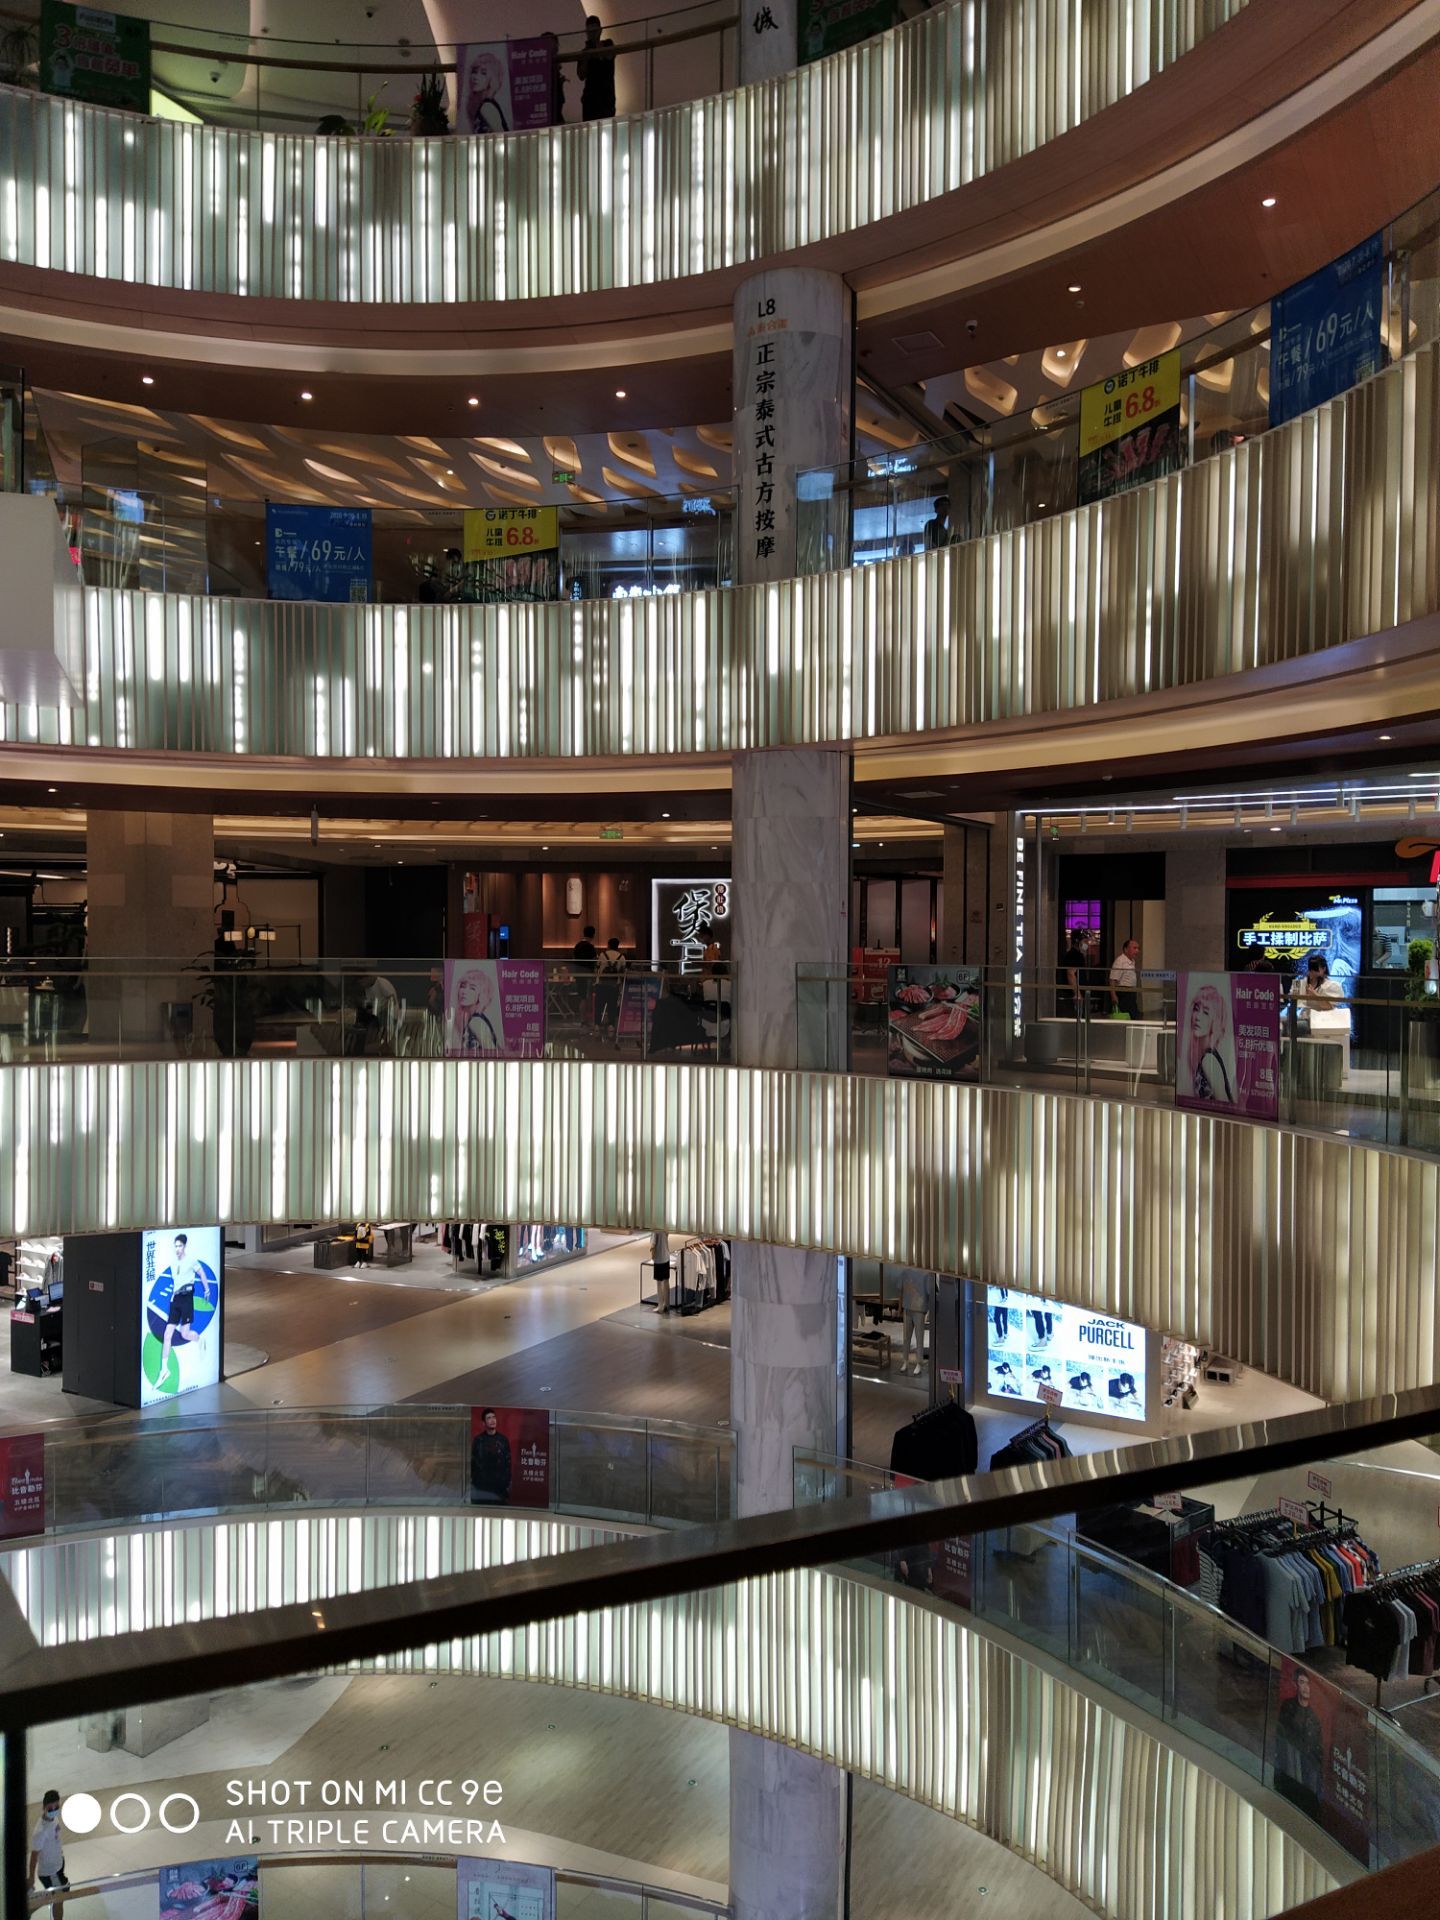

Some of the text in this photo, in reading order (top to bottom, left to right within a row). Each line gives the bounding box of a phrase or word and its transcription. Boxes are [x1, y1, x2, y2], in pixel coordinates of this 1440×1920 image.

[758, 299, 776, 317] L8
[1118, 360, 1160, 388] 诺丁牛排
[756, 343, 776, 559] 正宗泰式古方按摩
[1016, 922, 1024, 963] TEA
[1243, 932, 1327, 946] 手工揉制比萨
[501, 970, 539, 978] Hair Code
[1235, 988, 1275, 1000] Hair Code
[1087, 1319, 1126, 1329] JACK
[1079, 1325, 1135, 1349] PURCELL
